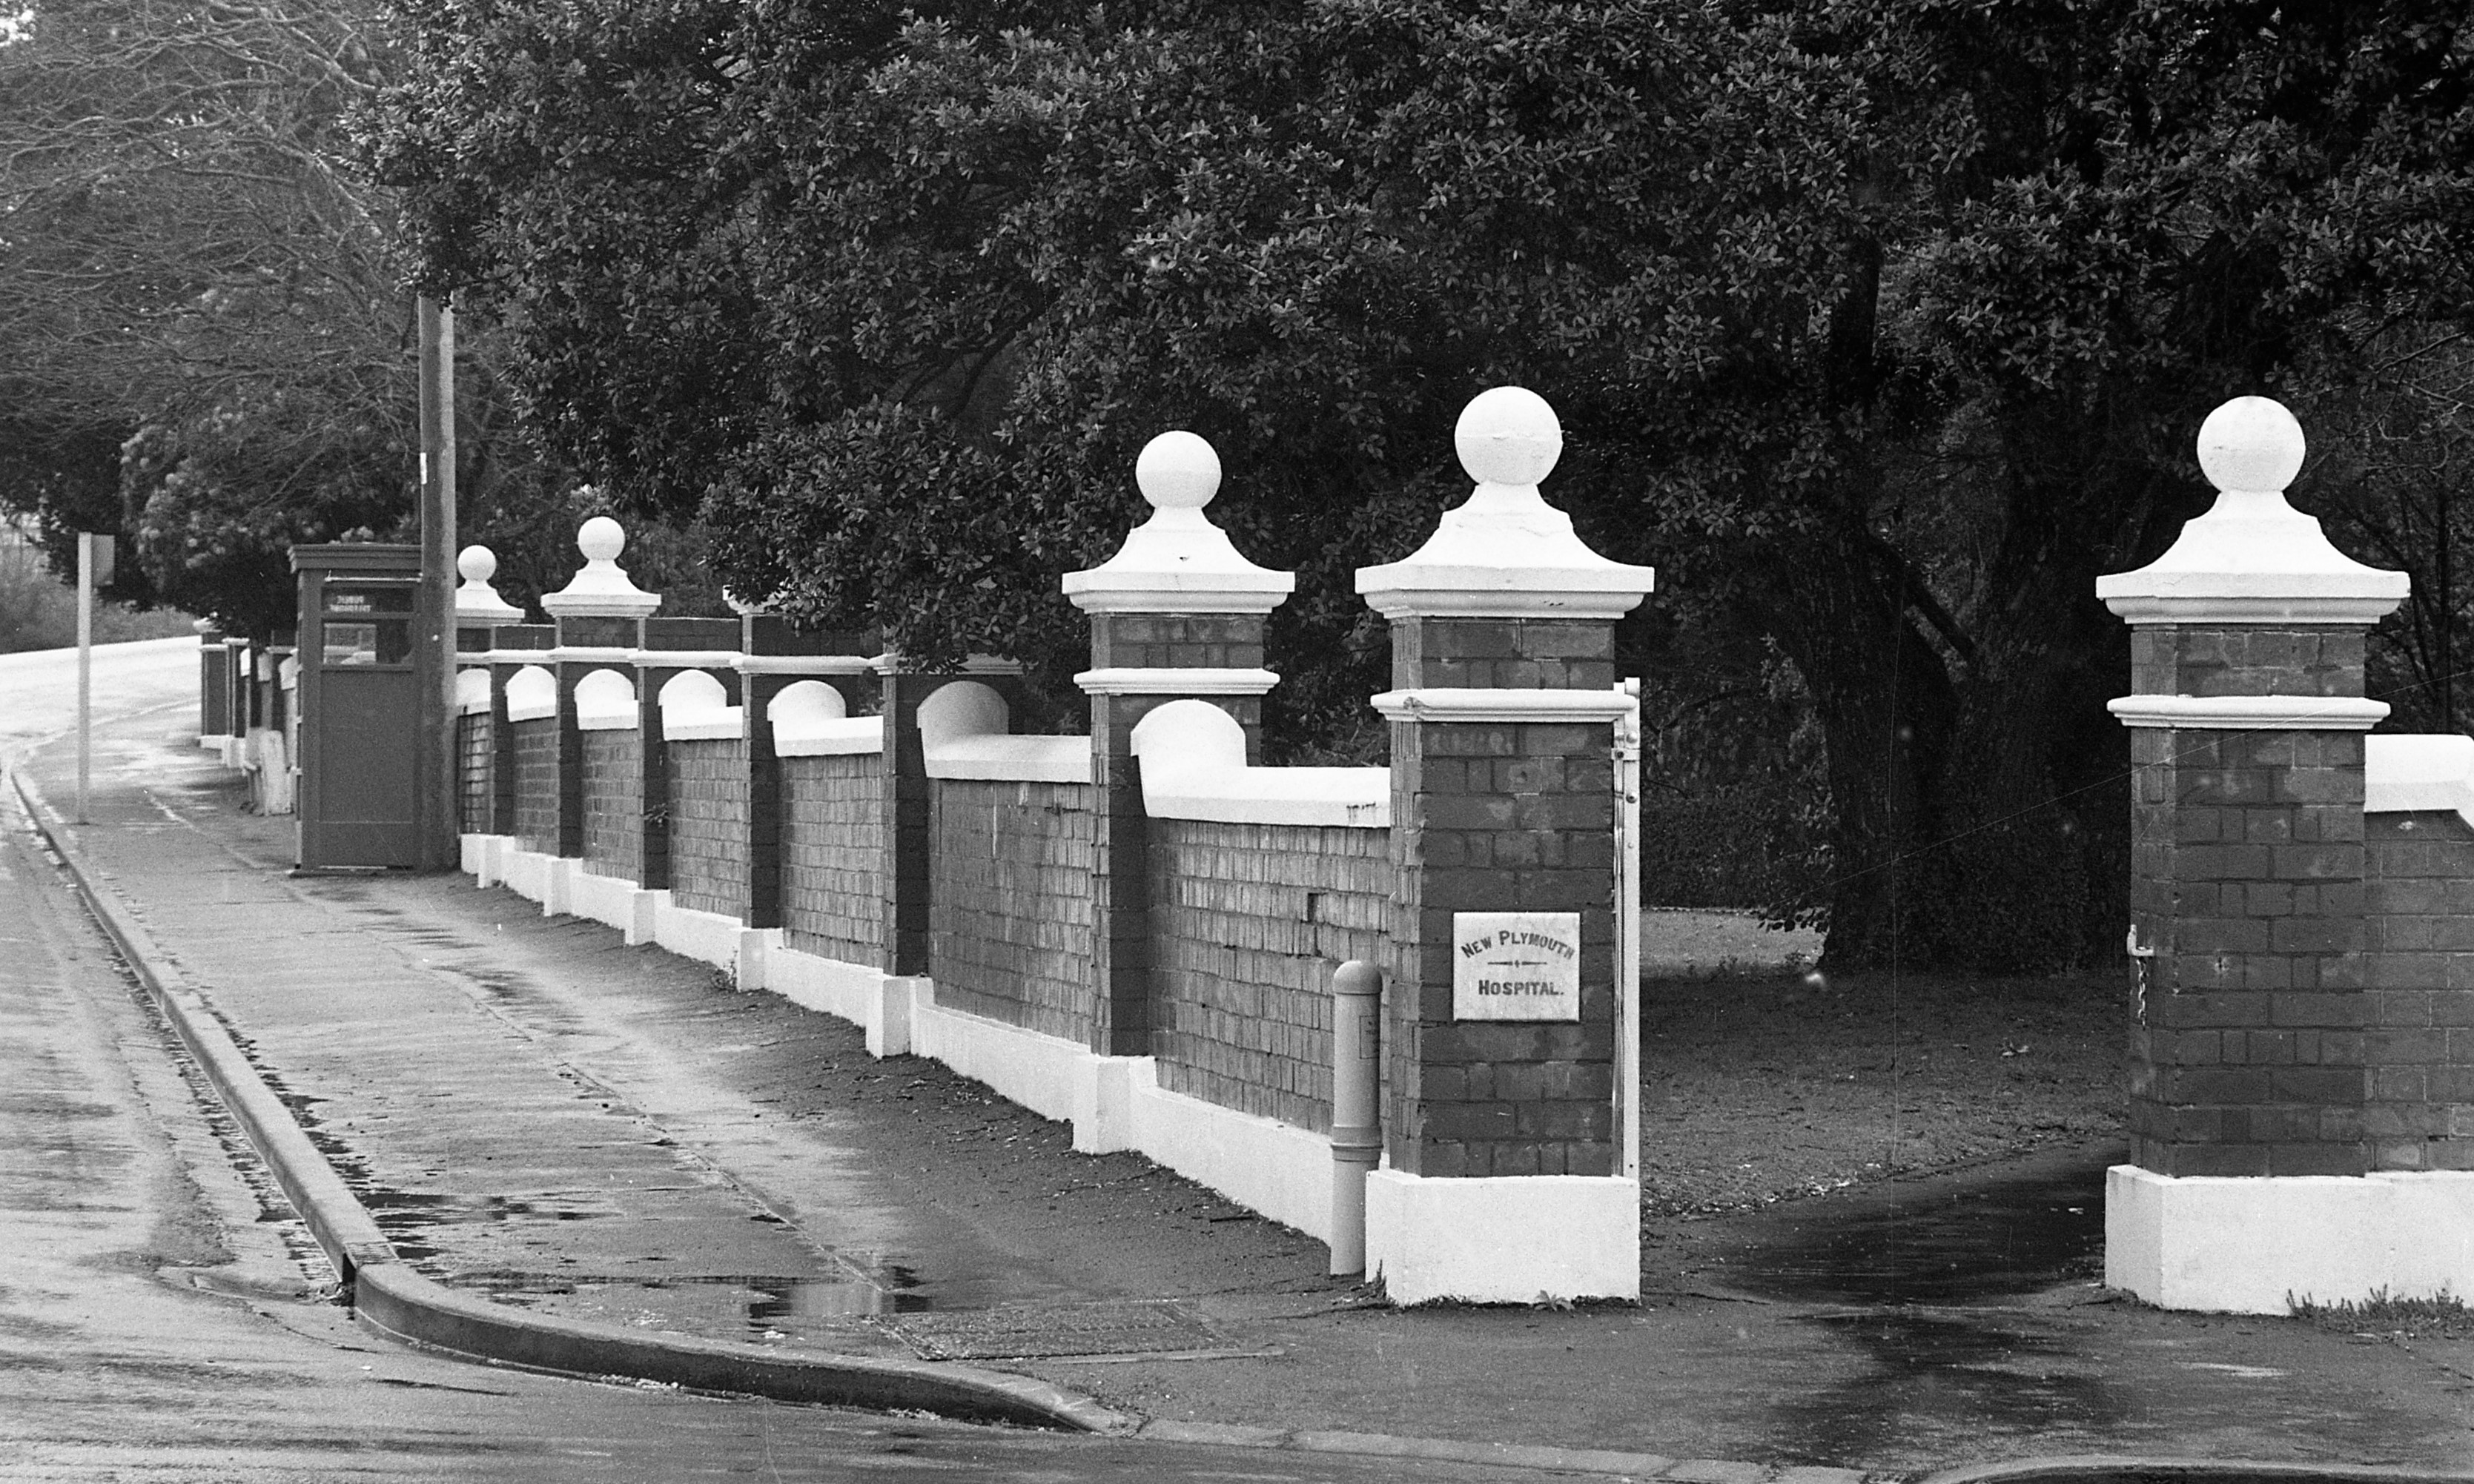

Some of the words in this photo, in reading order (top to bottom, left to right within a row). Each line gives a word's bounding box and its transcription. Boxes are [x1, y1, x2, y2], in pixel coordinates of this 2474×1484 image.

[1461, 936, 1492, 958] NEW
[1499, 930, 1575, 960] PLYMOUTH
[1478, 979, 1564, 996] HOSPITAL.
